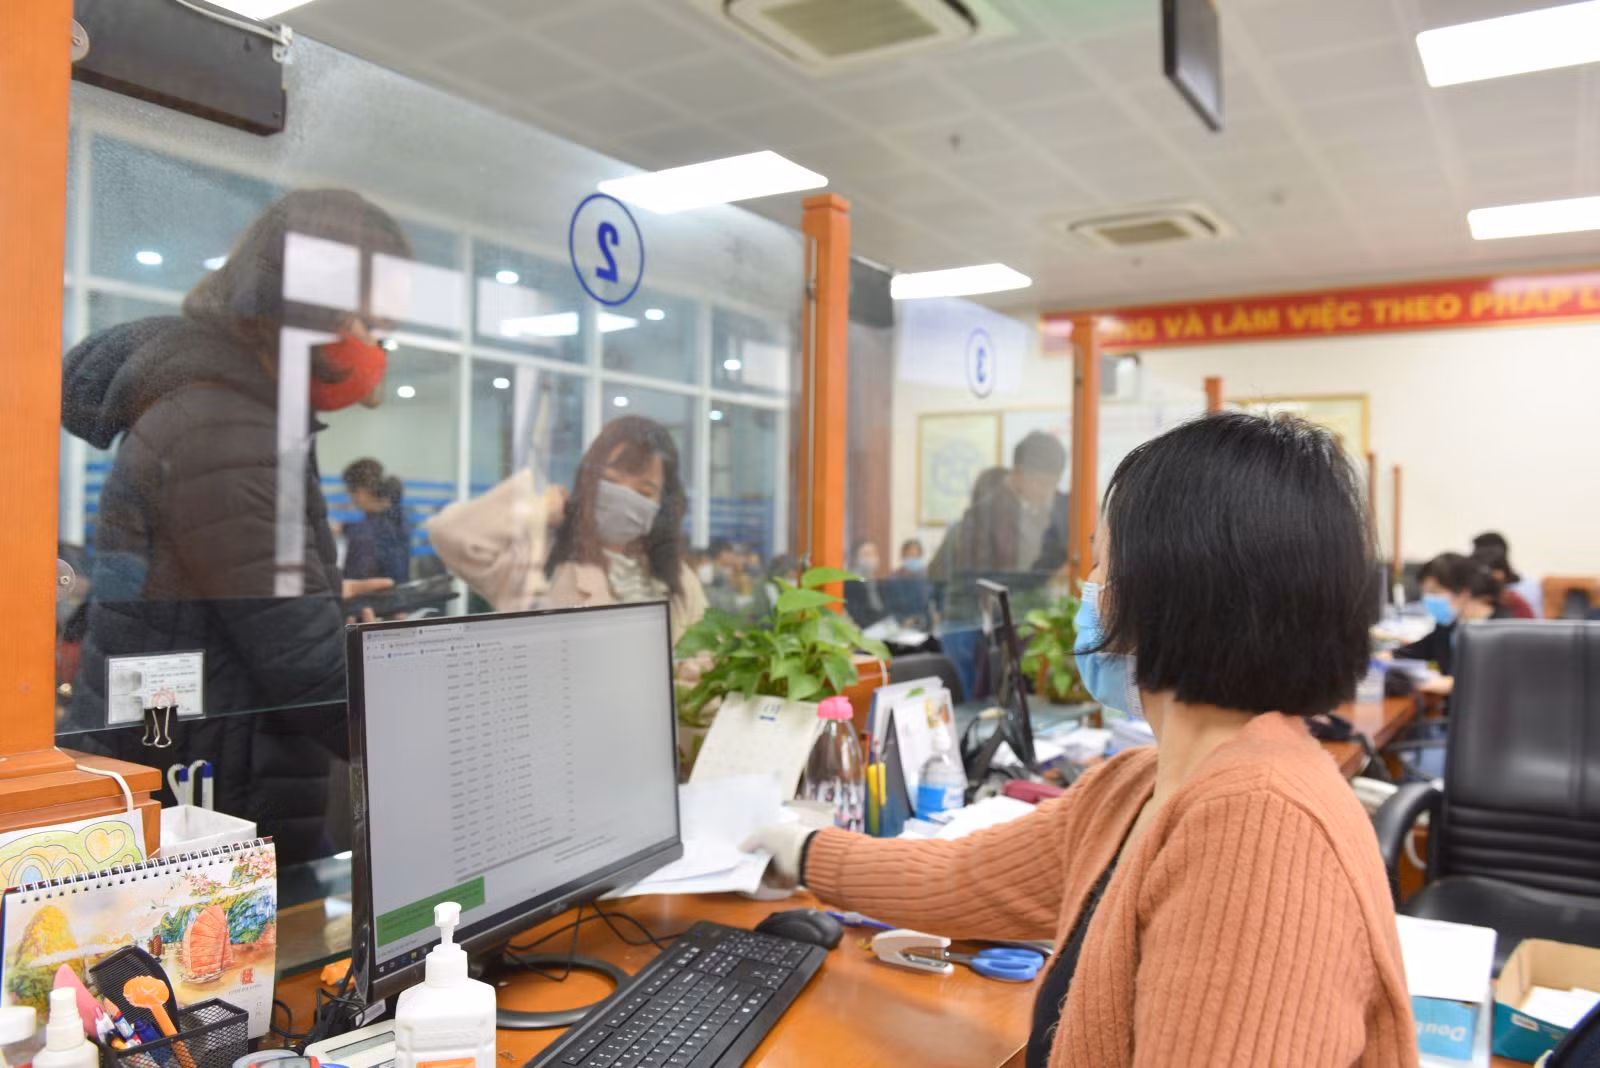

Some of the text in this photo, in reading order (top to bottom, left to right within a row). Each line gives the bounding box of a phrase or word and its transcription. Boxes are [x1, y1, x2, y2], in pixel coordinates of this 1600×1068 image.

[1163, 309, 1205, 339] VÀ
[1213, 304, 1280, 335] LÀM
[1287, 294, 1361, 333] VIỆC
[1371, 292, 1462, 324] THEO
[1580, 284, 1600, 310] L
